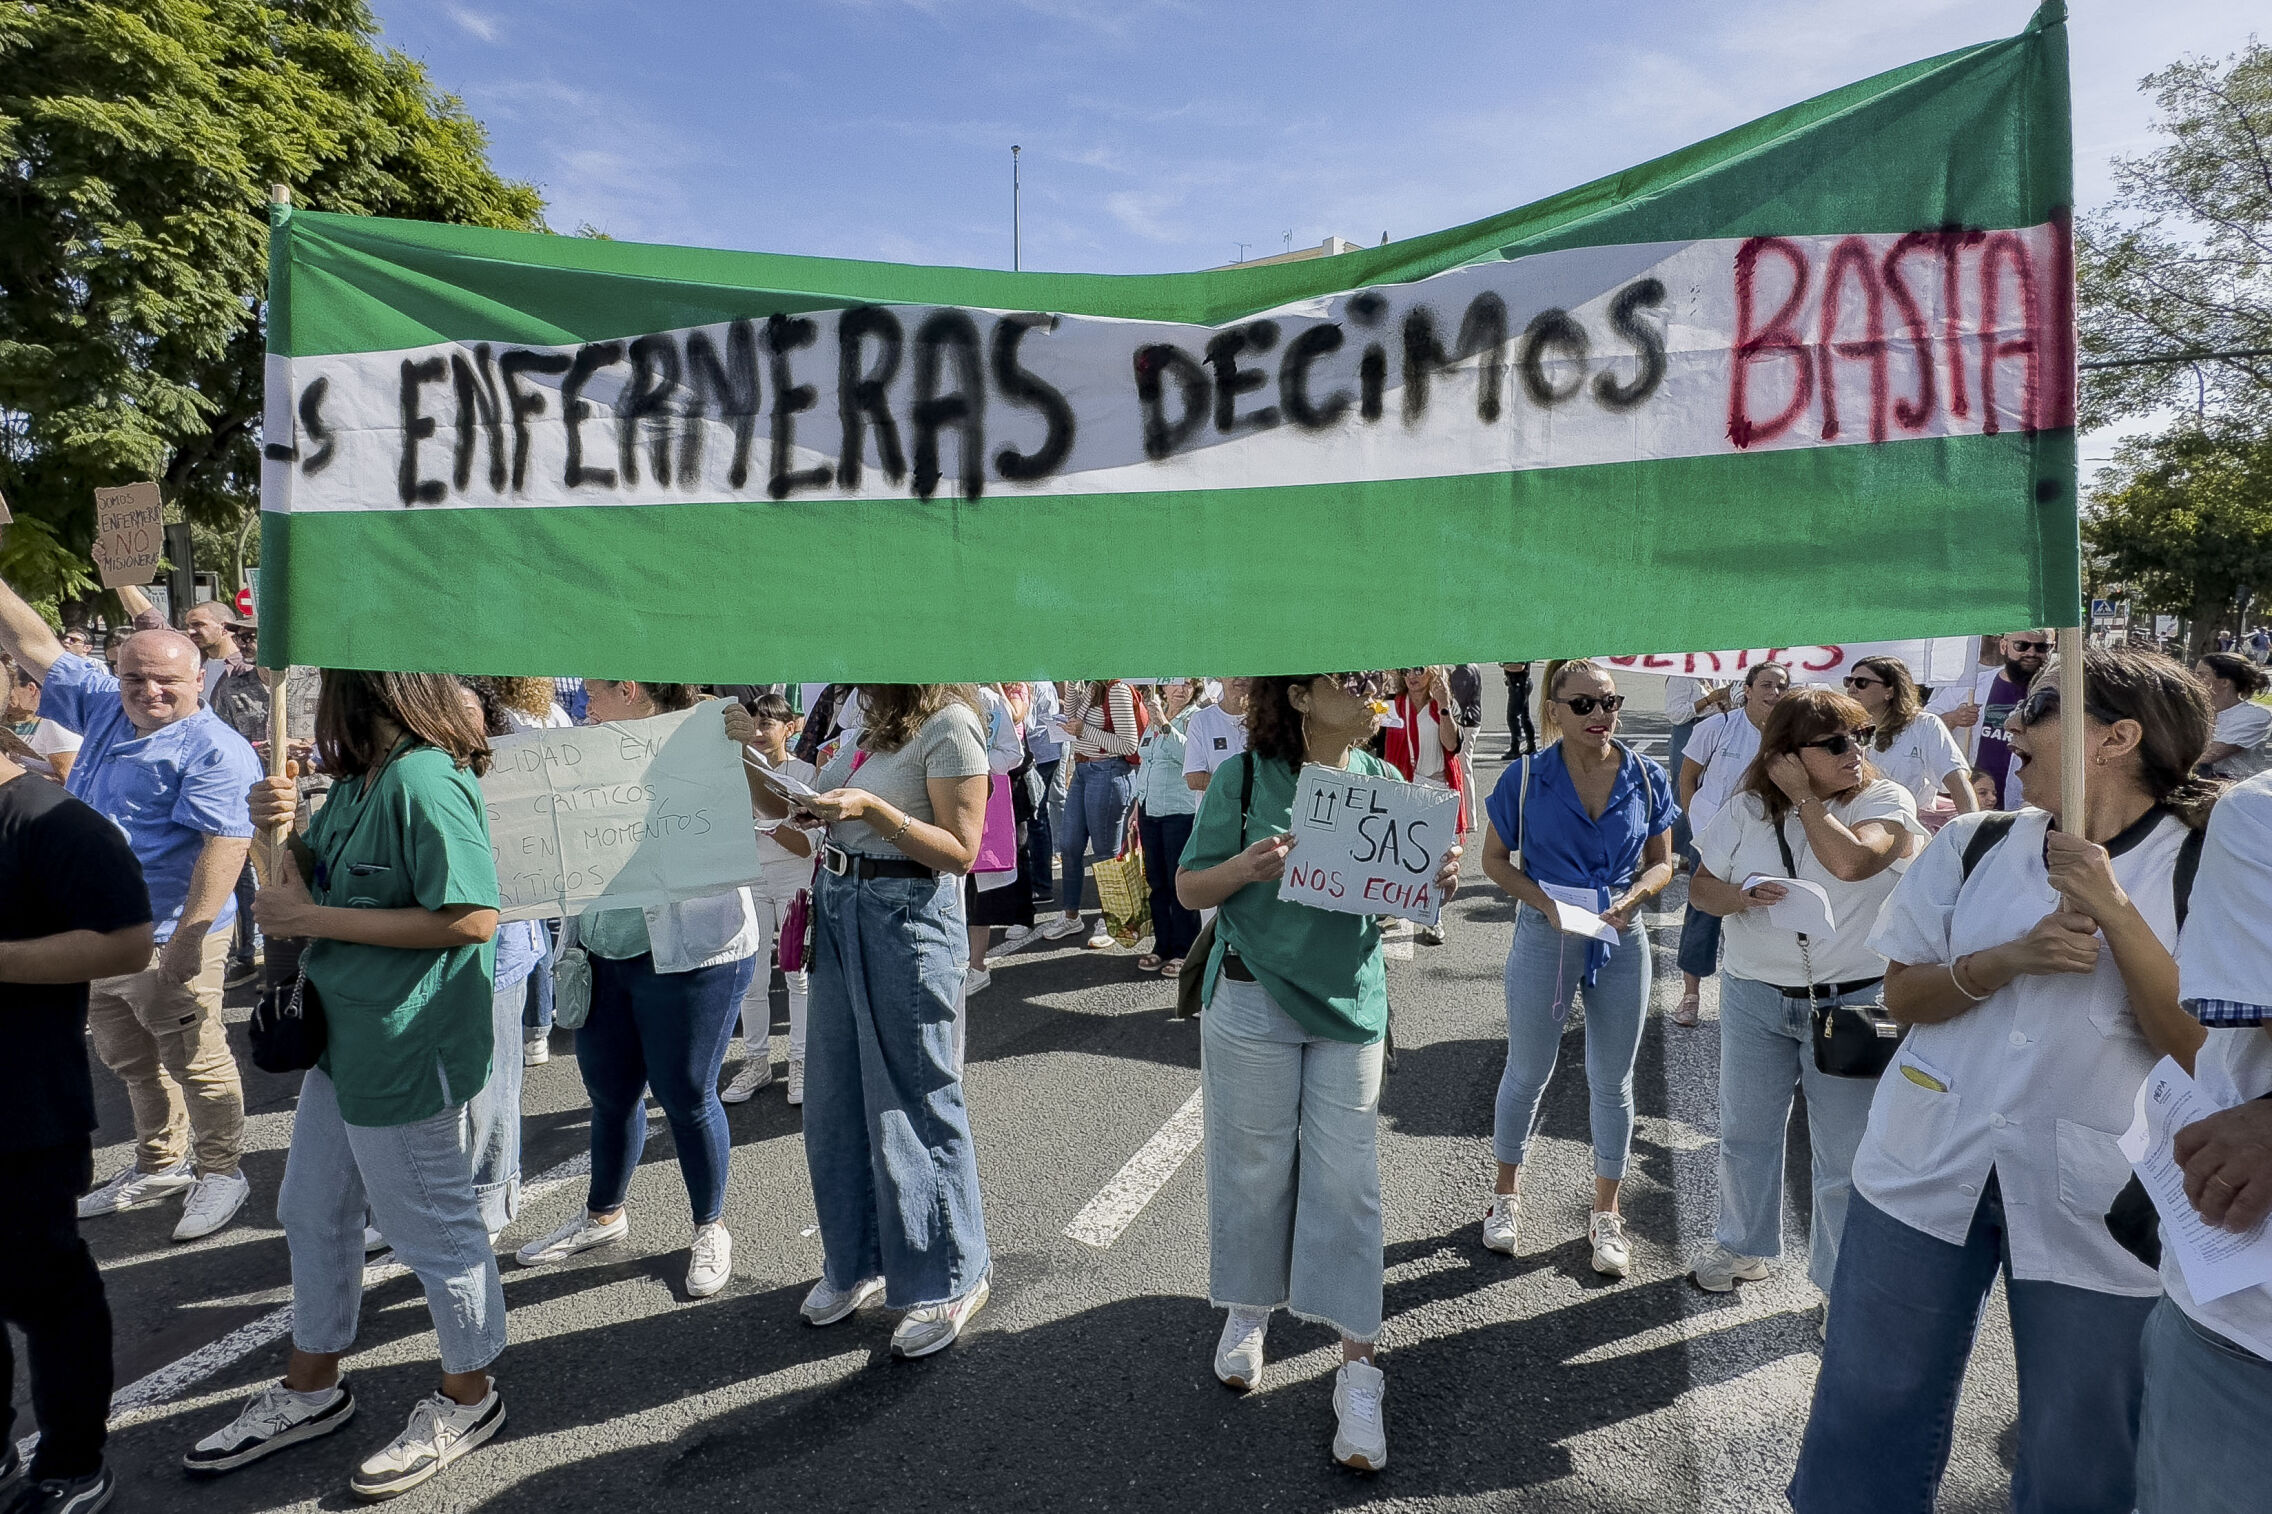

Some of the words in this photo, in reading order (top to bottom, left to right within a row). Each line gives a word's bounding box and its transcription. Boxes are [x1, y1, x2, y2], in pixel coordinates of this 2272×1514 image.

[98, 494, 135, 510] SOMOS
[116, 529, 149, 555] NO
[620, 736, 662, 761] EN
[1345, 787, 1388, 814] EL
[522, 835, 554, 857] EN
[1350, 816, 1430, 874] SAS
[1290, 861, 1344, 897] NOS
[1363, 877, 1429, 909] ECHA
